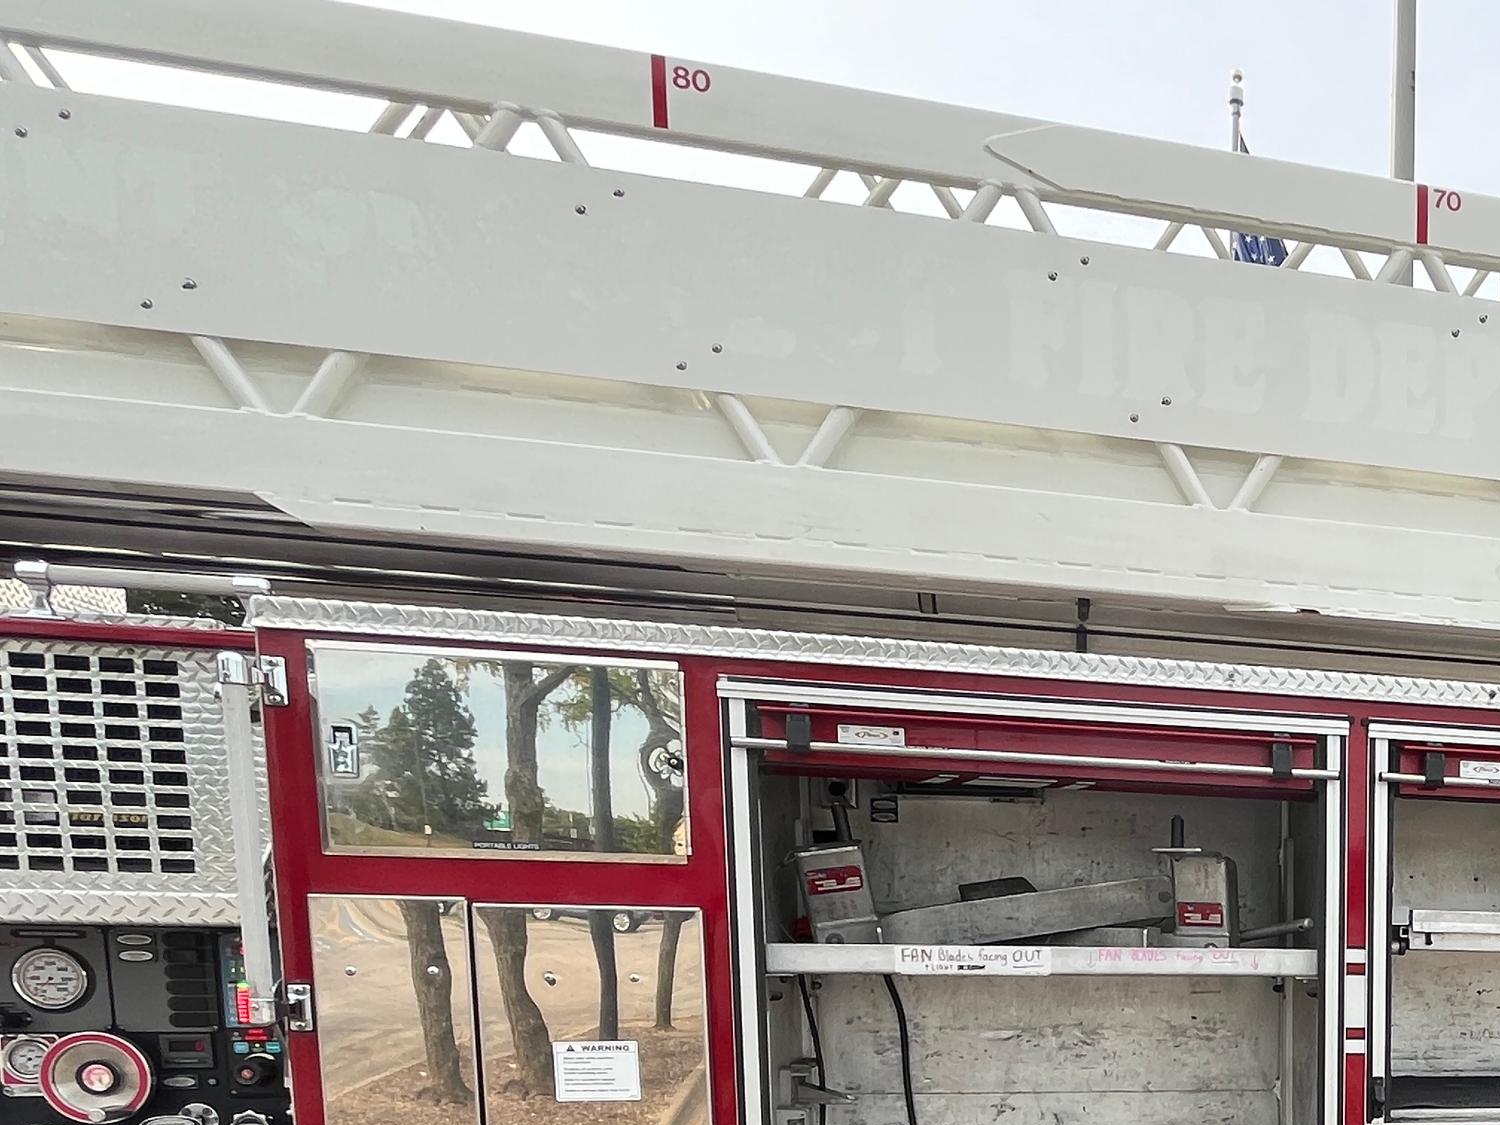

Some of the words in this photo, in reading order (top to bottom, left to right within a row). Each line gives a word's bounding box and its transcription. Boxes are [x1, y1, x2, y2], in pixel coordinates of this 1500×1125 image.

[673, 65, 710, 92] 80
[1433, 188, 1461, 211] 70
[901, 949, 932, 963] FAN
[937, 949, 974, 962] Blades
[978, 950, 1007, 965] facing
[1013, 950, 1042, 963] OUT
[1098, 950, 1122, 961] FAN
[581, 1044, 629, 1052] WARNING
